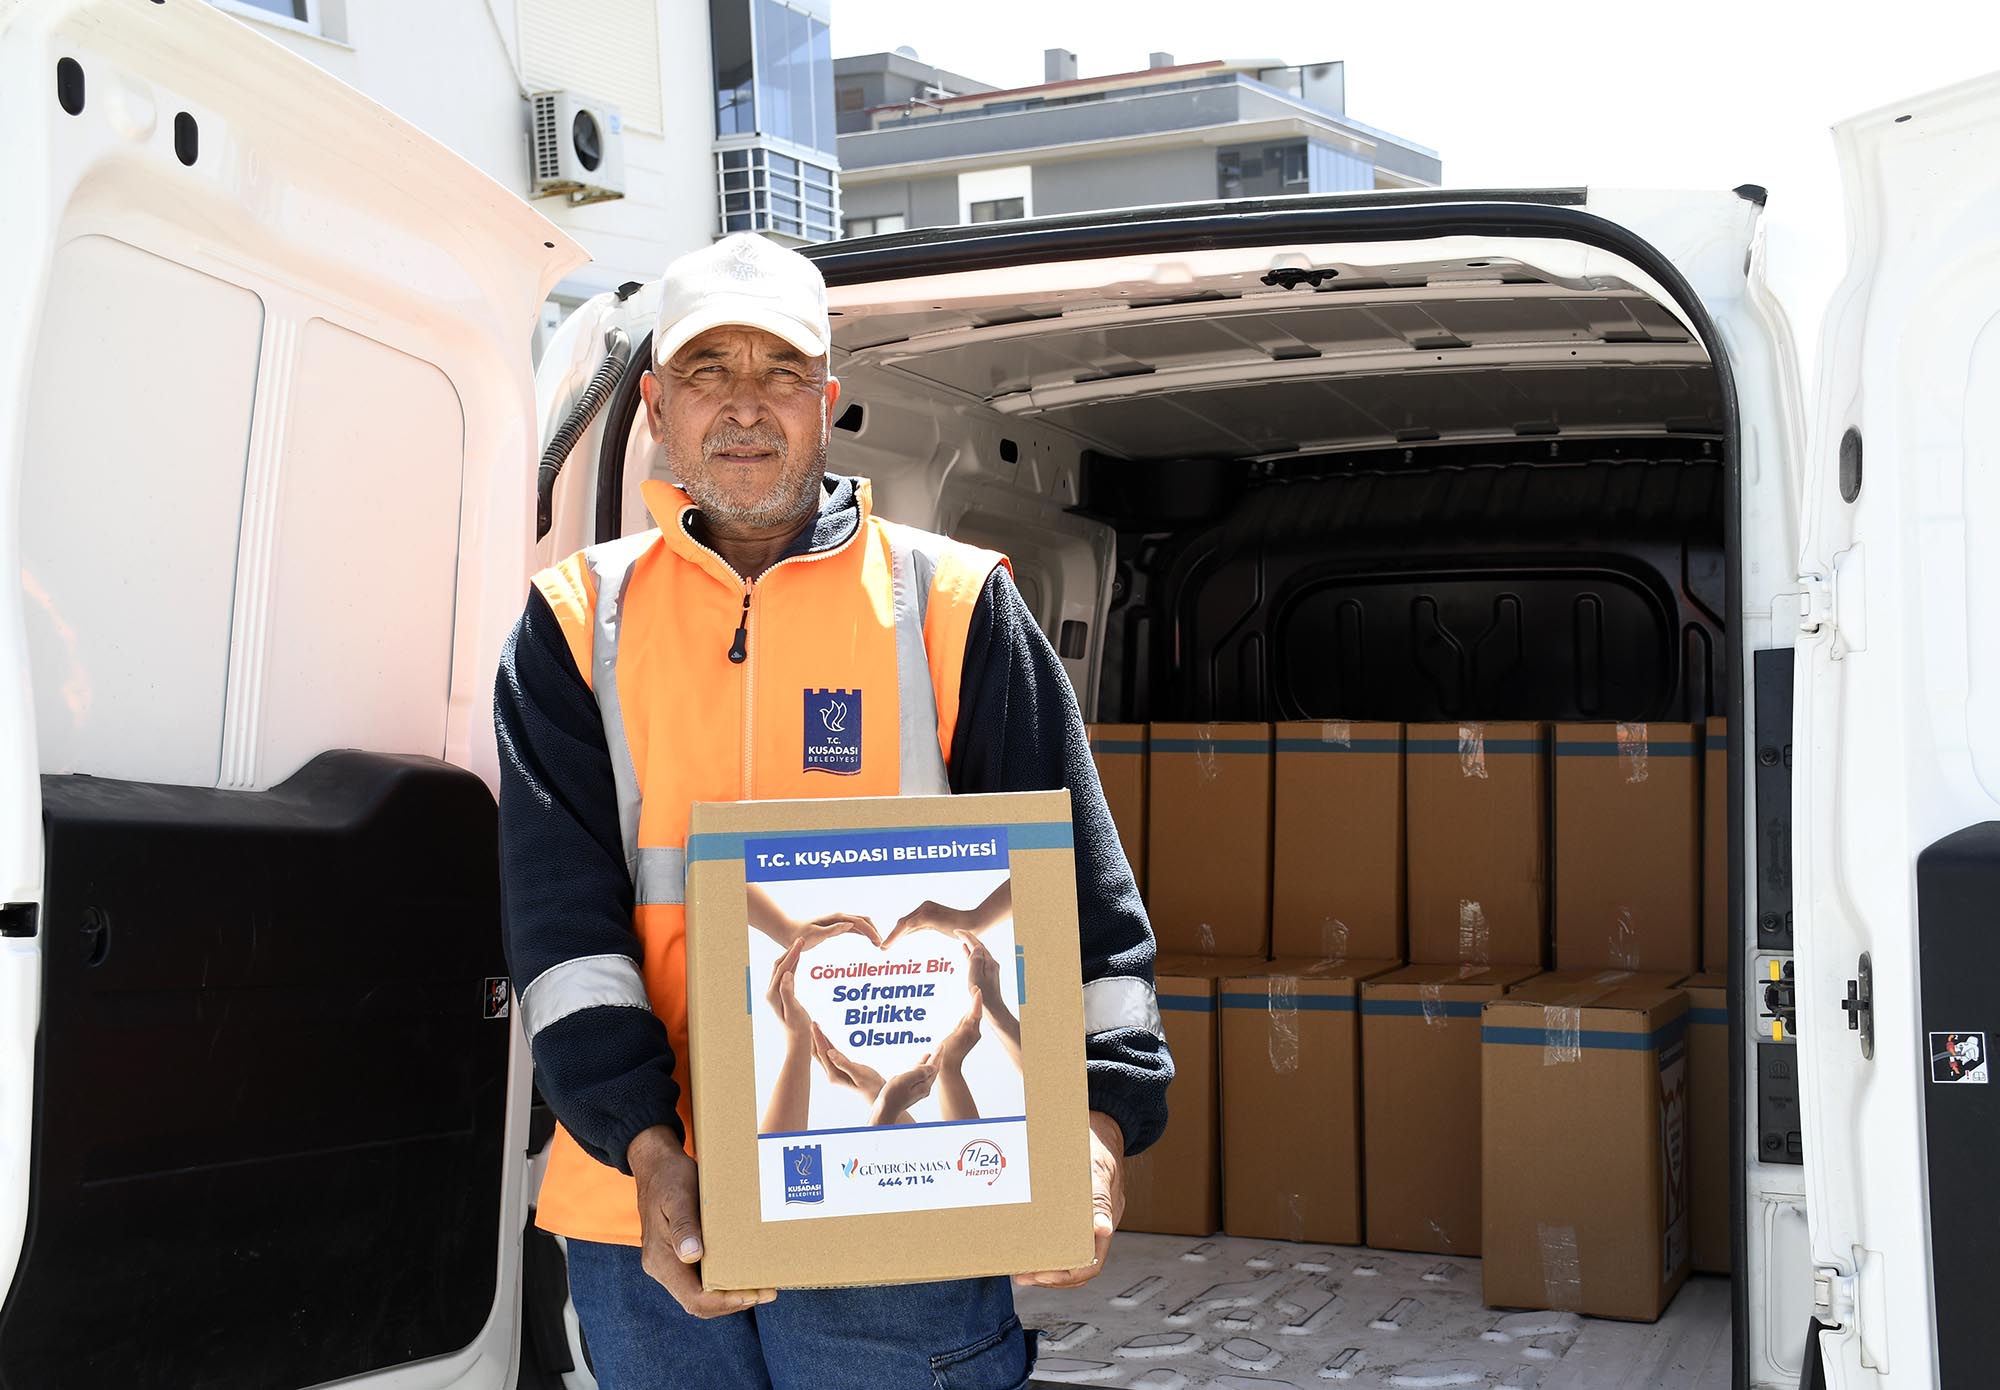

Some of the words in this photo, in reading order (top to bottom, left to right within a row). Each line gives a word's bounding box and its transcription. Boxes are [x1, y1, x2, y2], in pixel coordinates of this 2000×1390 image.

[808, 746, 858, 755] KUŞADASI
[757, 853, 790, 868] T.C.
[795, 848, 888, 868] KUŞADASI
[893, 839, 997, 861] BELEDİYESİ
[810, 960, 921, 979] Gönüllerimiz
[926, 957, 955, 975] Bir,
[832, 981, 935, 1002] Soframız
[844, 1004, 926, 1025] Birlikte
[849, 1028, 931, 1047] Olsun...
[860, 1161, 917, 1177] GÜVERCİN
[920, 1160, 951, 1172] MASA
[965, 1166, 999, 1177] Hizmet
[878, 1176, 902, 1187] 444
[905, 1175, 918, 1186] 71
[921, 1175, 934, 1185] 14
